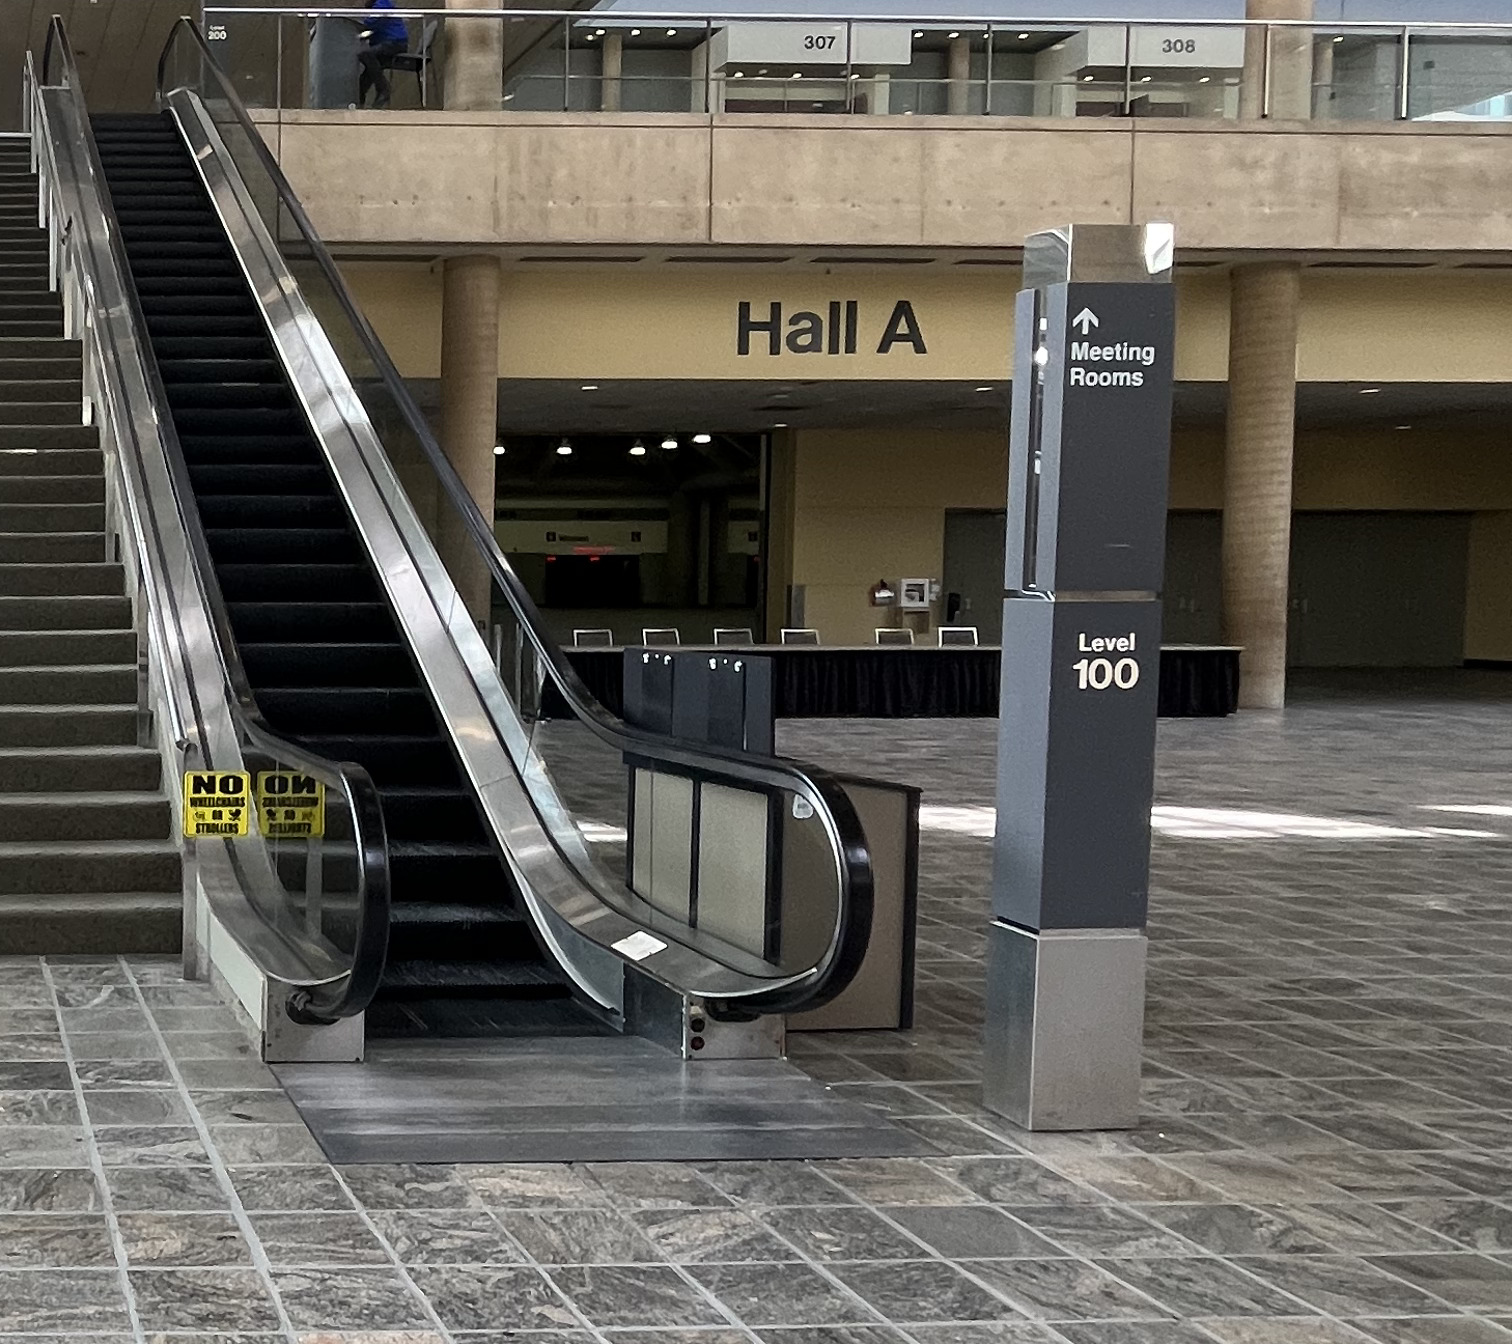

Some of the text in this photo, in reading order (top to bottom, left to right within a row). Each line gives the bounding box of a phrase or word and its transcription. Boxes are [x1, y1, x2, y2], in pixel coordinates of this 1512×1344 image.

[208, 30, 227, 40] 200
[804, 35, 836, 50] 307
[1162, 38, 1196, 53] 308
[738, 300, 928, 355] Hall A
[1070, 341, 1155, 366] Meeting
[1070, 367, 1144, 387] Rooms
[1078, 632, 1136, 652] Level
[1072, 657, 1140, 690] 100
[192, 775, 244, 794] NO
